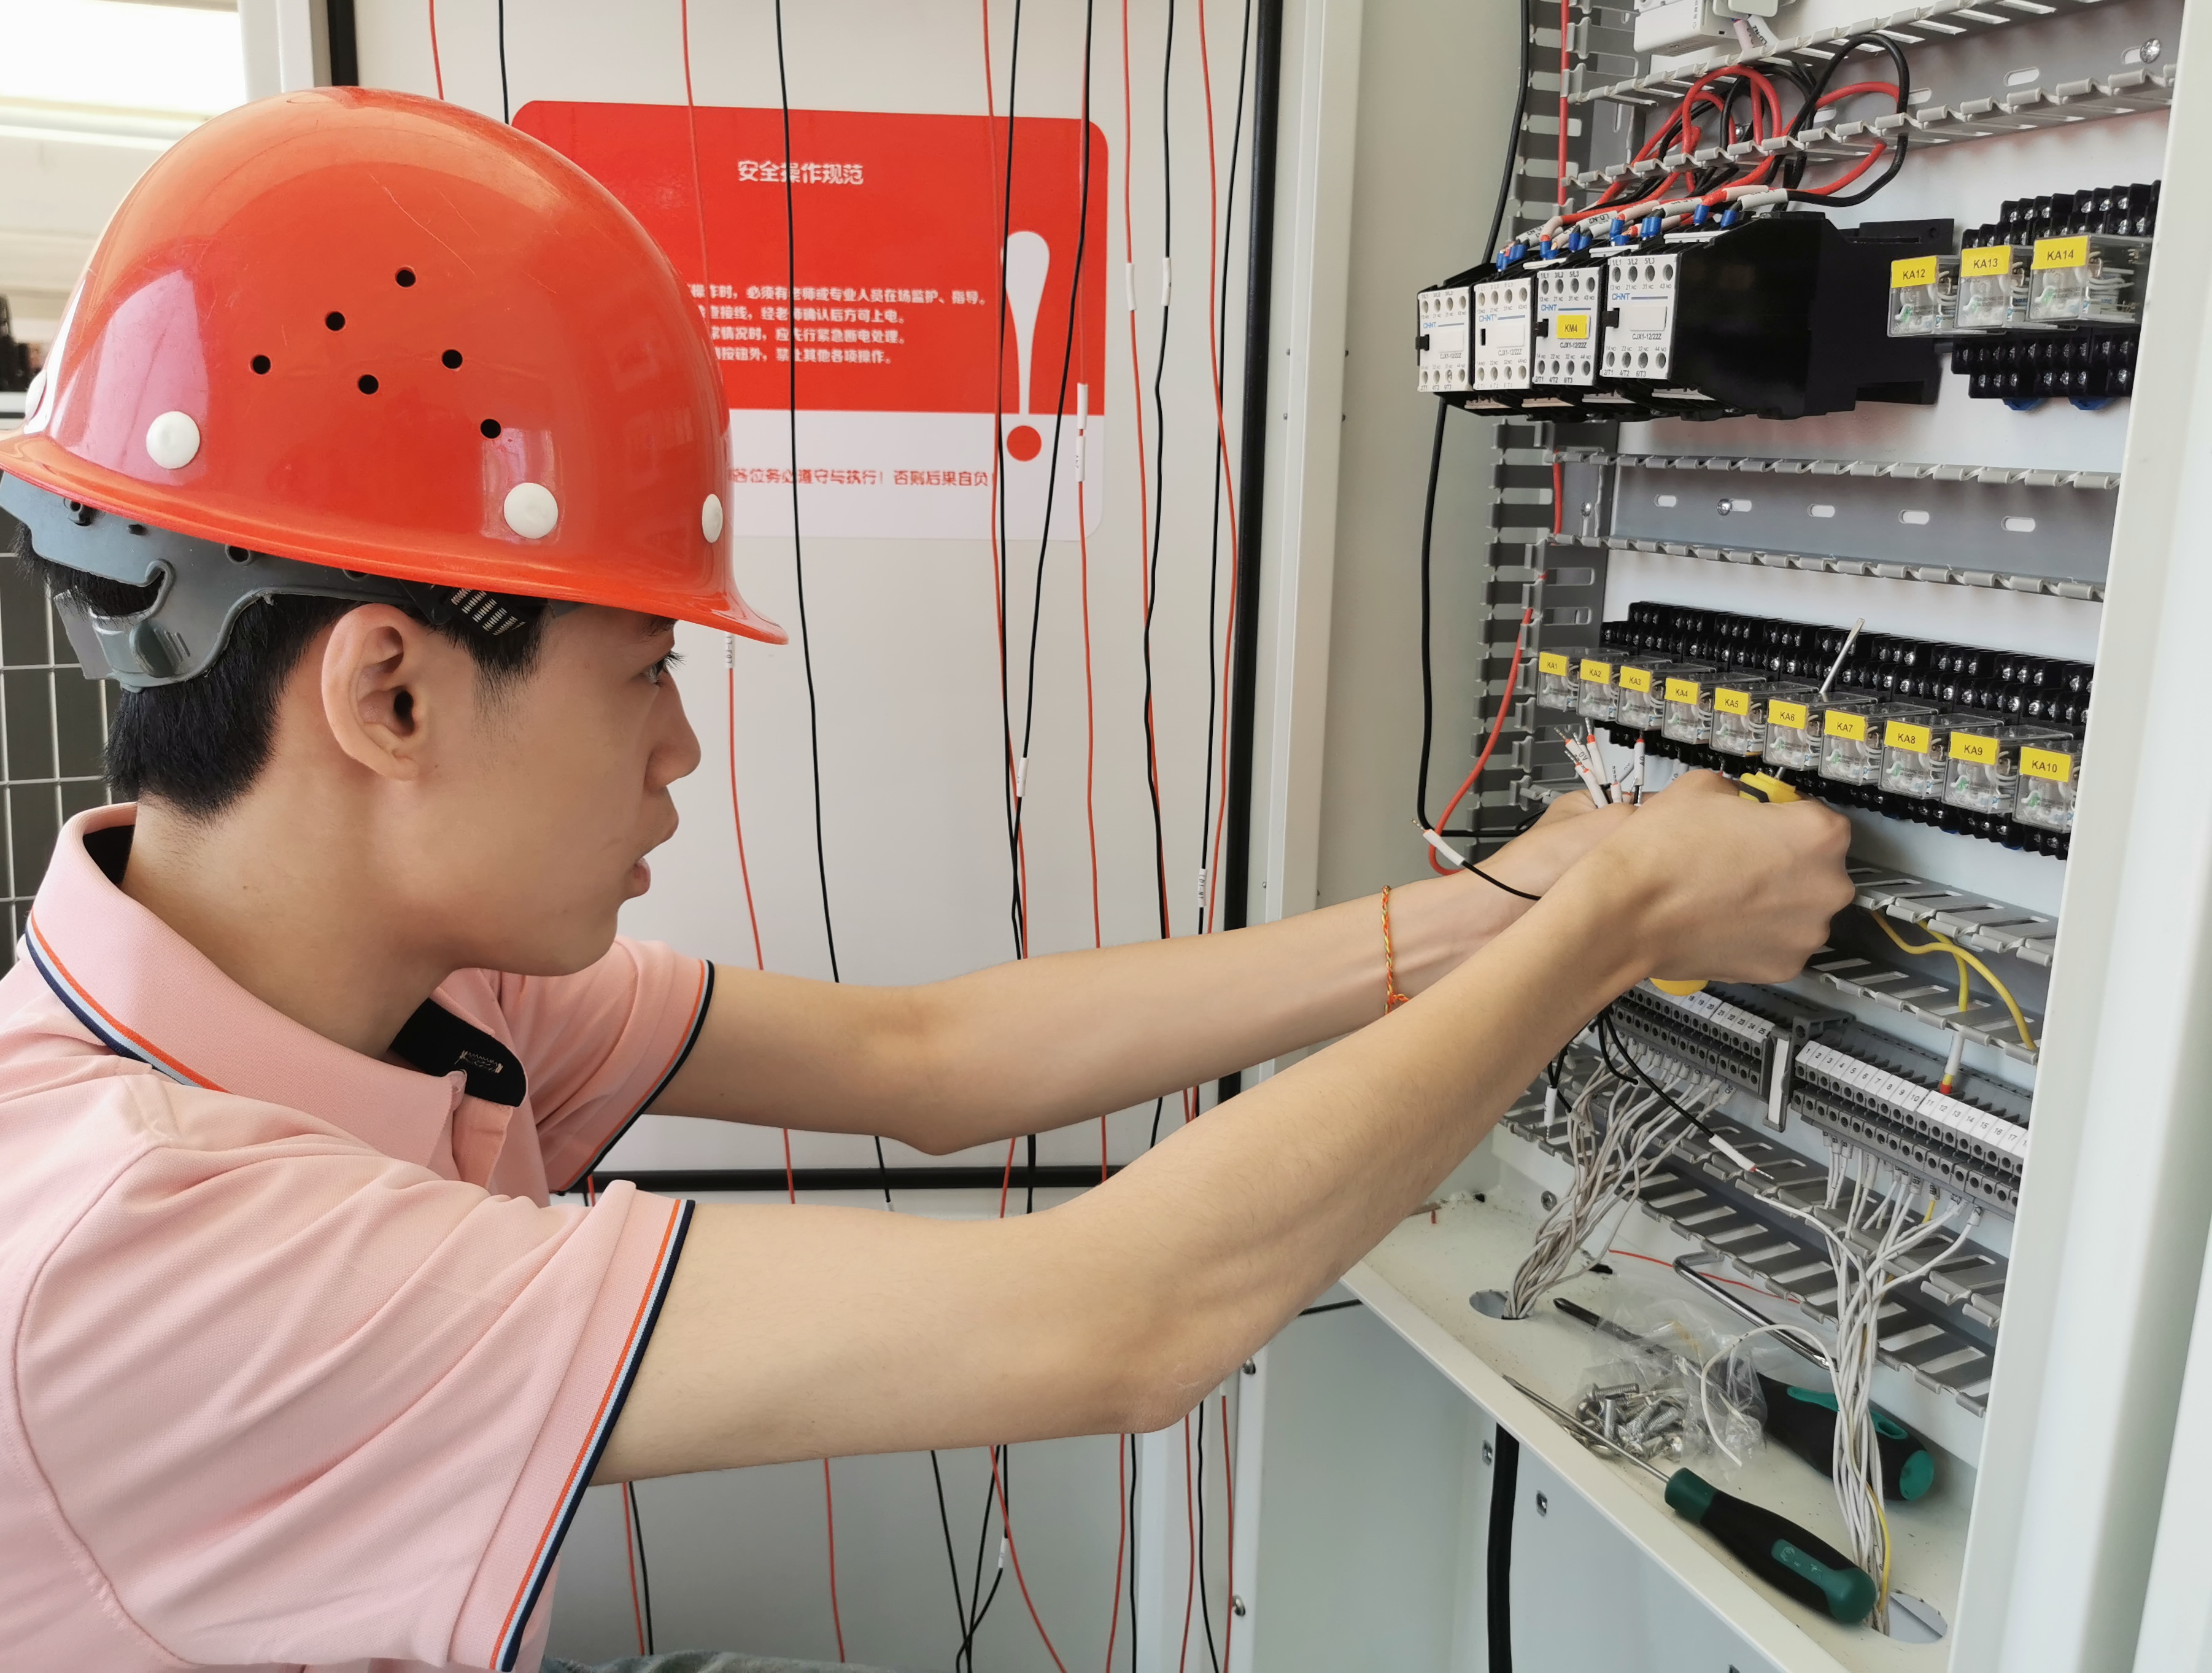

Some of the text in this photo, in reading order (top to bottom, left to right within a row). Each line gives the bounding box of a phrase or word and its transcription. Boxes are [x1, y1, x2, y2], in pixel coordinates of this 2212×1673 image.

[738, 160, 864, 185] 安全操作规范
[2046, 249, 2074, 261] KA14
[1973, 258, 1998, 269] KA13
[1903, 268, 1925, 280] KA12
[1564, 324, 1577, 333] KM4
[1547, 661, 1557, 670] KA1
[1589, 668, 1601, 678] KA2
[1629, 676, 1641, 686] KA3
[1675, 688, 1688, 698] KA4
[1725, 698, 1739, 708] KA5
[1780, 711, 1795, 721] KA6
[1836, 722, 1853, 732] KA7
[1897, 733, 1916, 744] KA8
[1964, 744, 1982, 756] KA9
[2032, 759, 2057, 773] KA10
